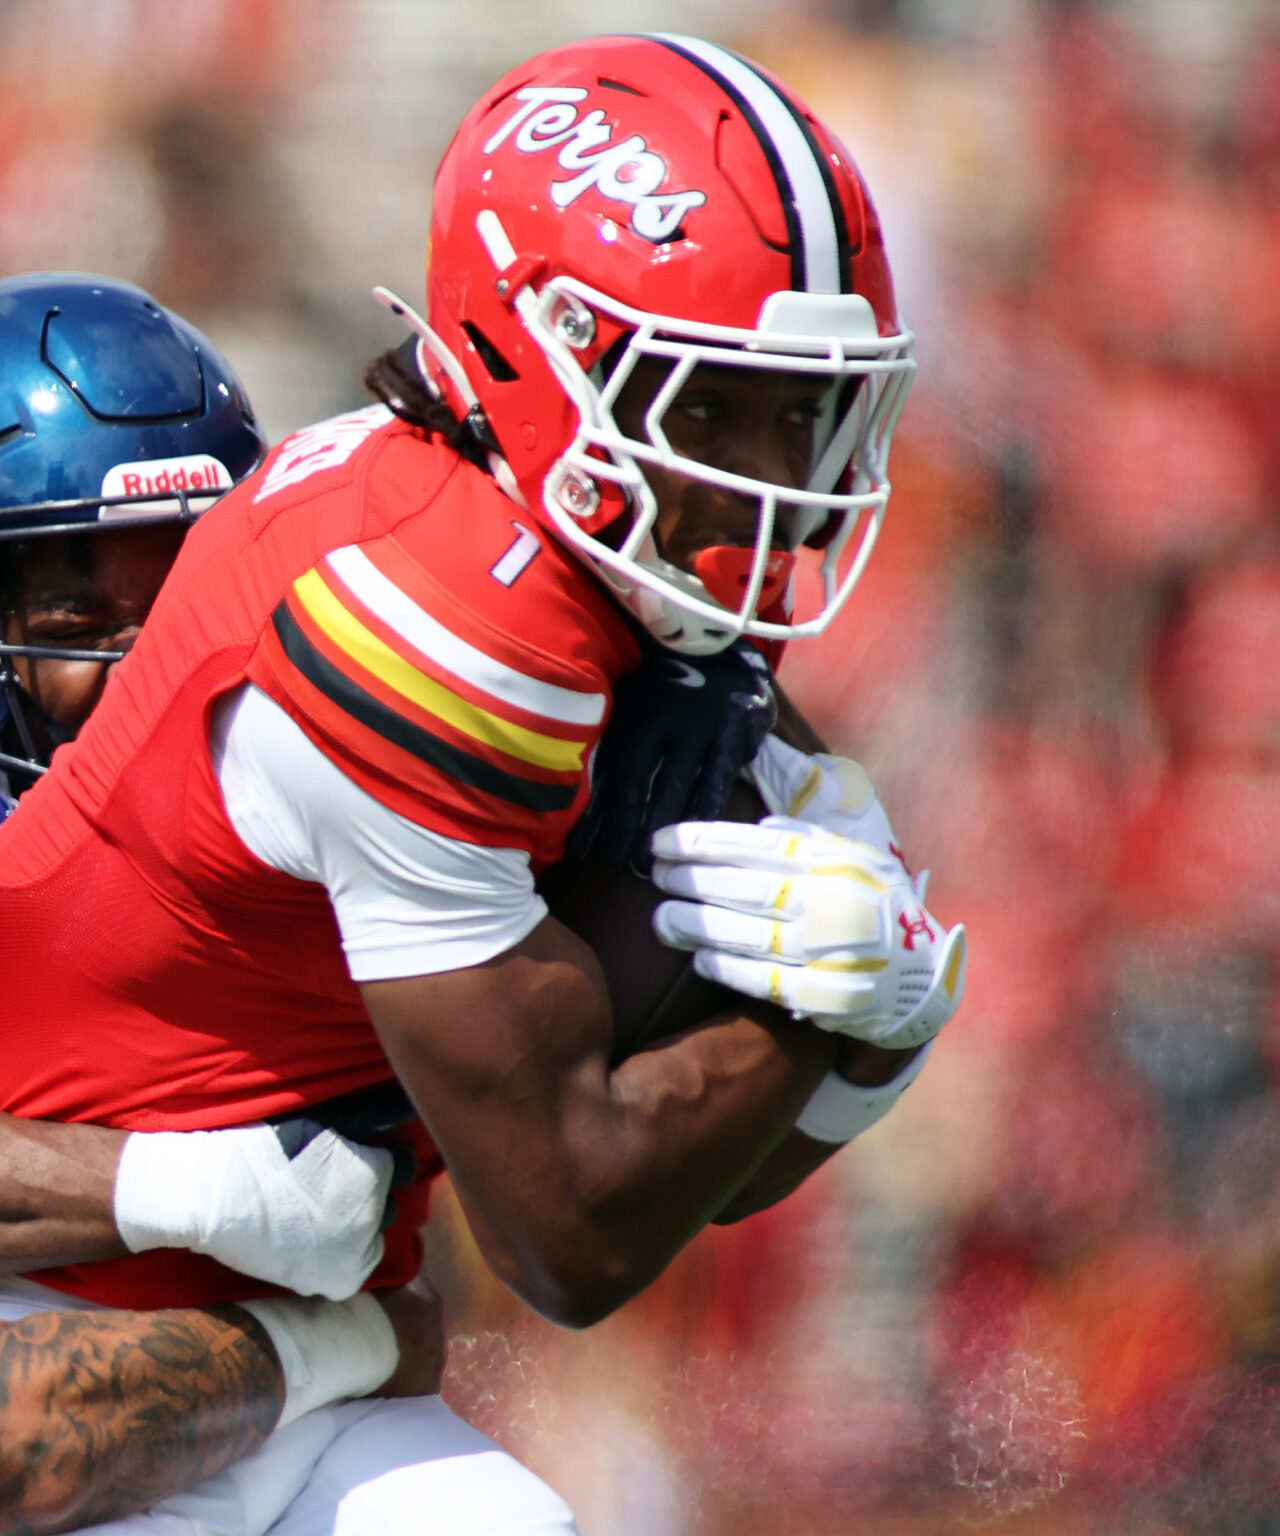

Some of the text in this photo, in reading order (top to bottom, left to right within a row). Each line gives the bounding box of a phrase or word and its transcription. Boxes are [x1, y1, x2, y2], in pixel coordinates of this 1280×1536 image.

[483, 86, 707, 242] Terps
[122, 464, 220, 496] Riddell
[488, 519, 542, 589] 1
